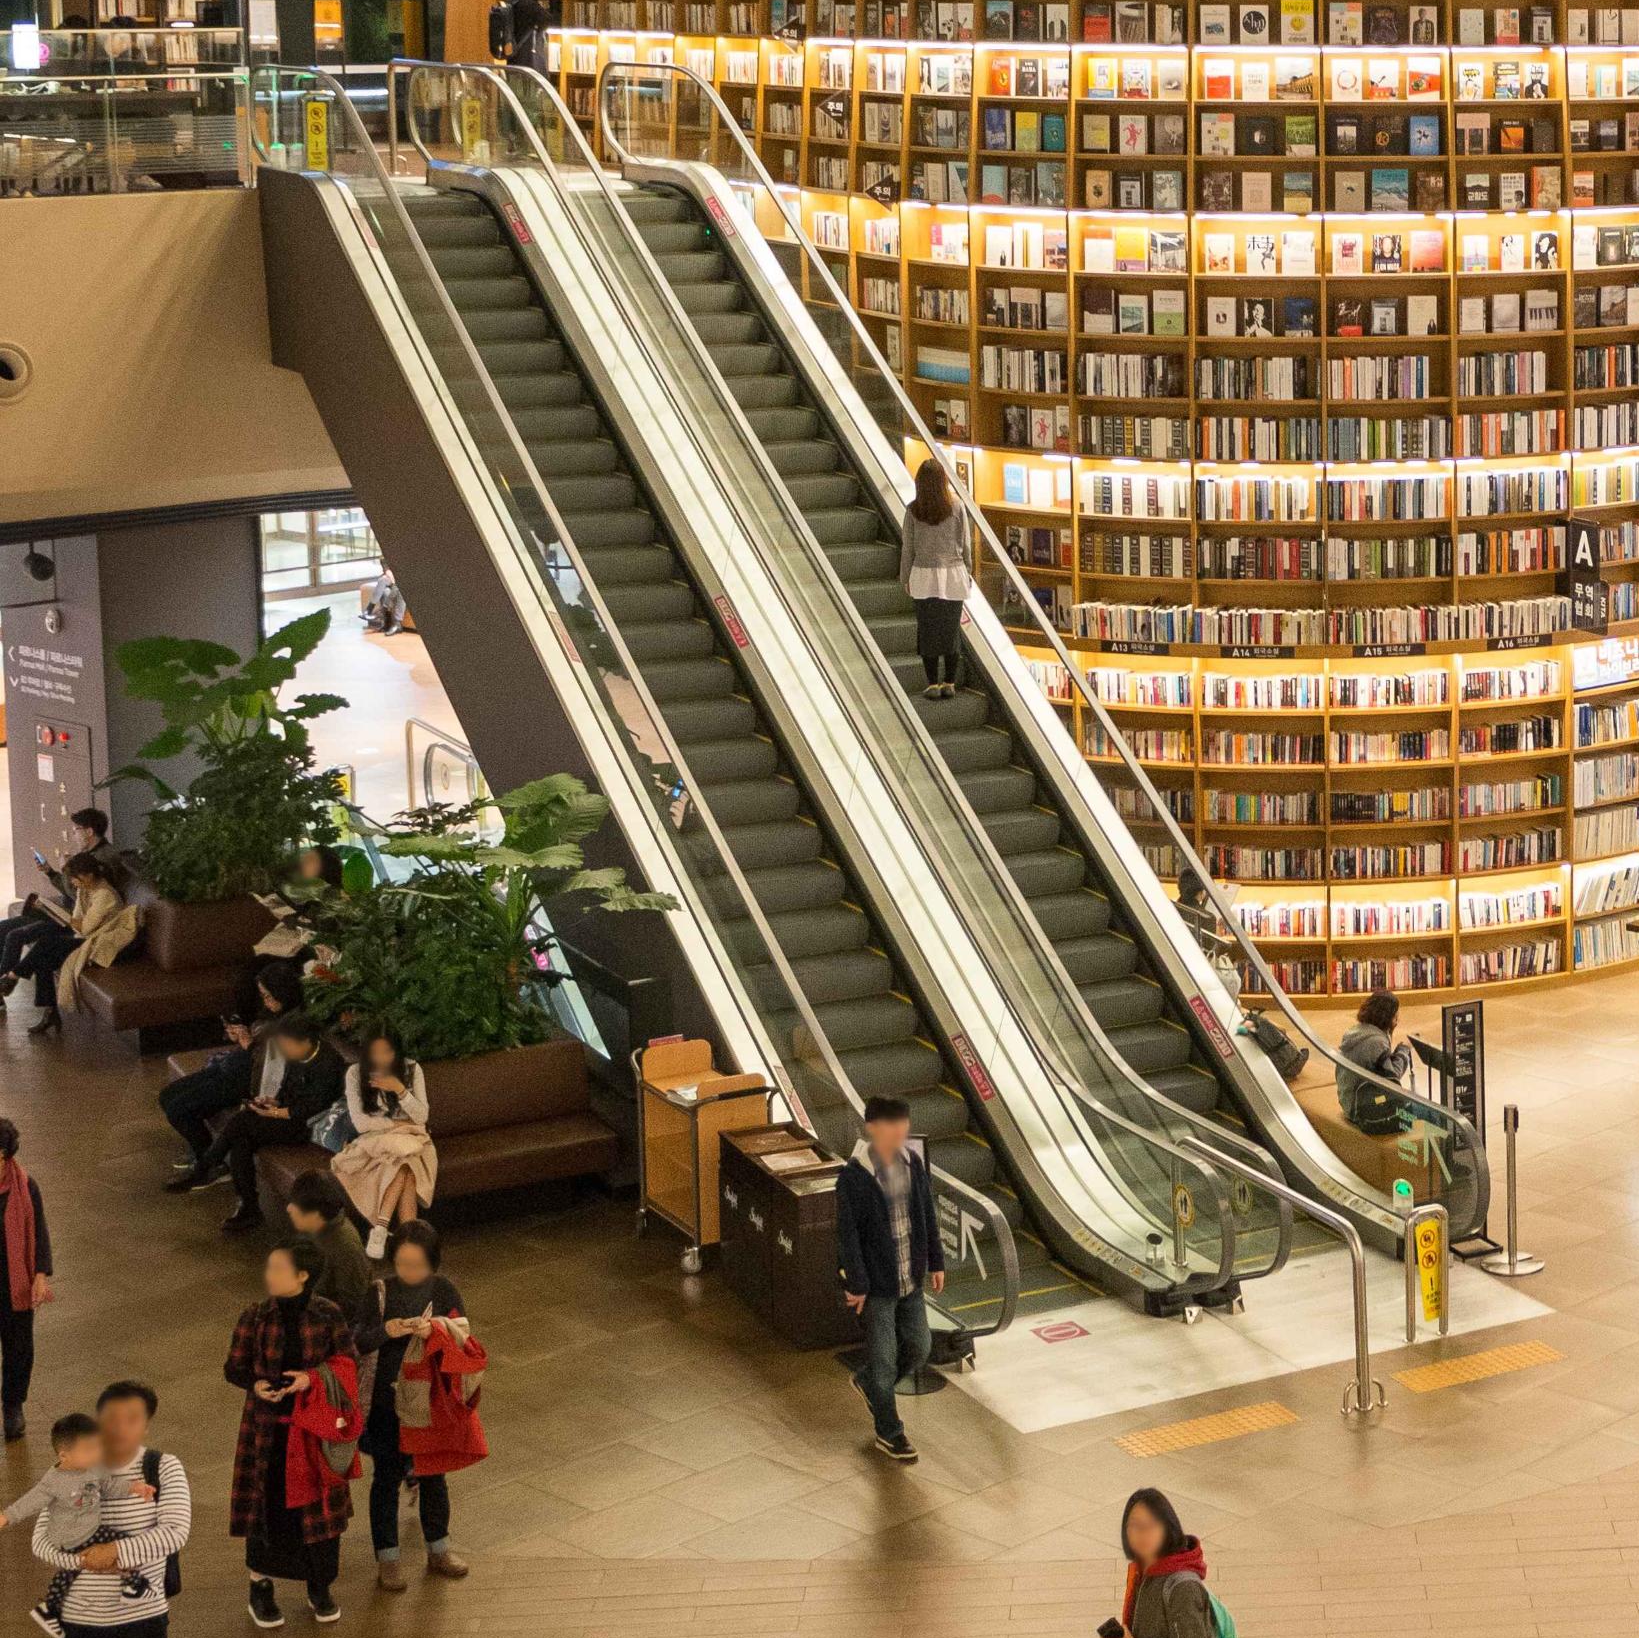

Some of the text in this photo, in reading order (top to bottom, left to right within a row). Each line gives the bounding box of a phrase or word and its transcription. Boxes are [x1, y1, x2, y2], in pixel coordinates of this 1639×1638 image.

[1575, 530, 1593, 567] A
[1574, 582, 1594, 601] 무역
[1111, 642, 1128, 653] A13
[1497, 638, 1514, 649] A16
[1232, 647, 1250, 658] A14
[1364, 646, 1382, 657] A15
